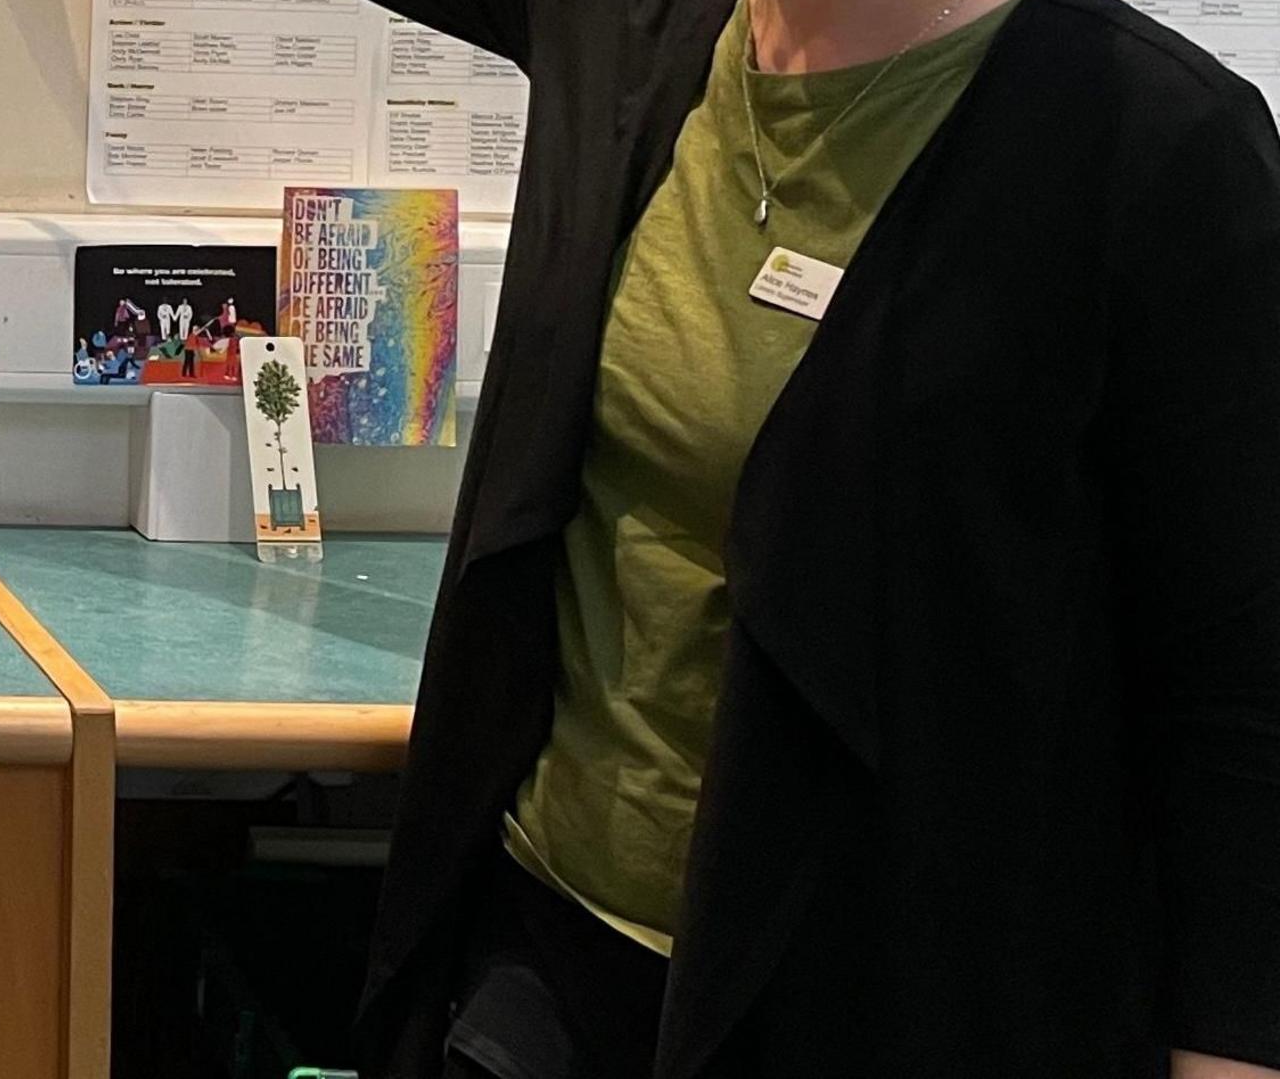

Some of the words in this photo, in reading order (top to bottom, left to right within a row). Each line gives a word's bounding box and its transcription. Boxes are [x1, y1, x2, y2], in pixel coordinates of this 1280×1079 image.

[294, 198, 342, 221] DON'T
[294, 223, 314, 245] BE
[318, 223, 371, 246] AFRAID
[293, 247, 313, 270] OF
[318, 248, 362, 270] BEING
[144, 278, 160, 286] not
[154, 268, 170, 276] you
[292, 296, 311, 318] BE
[315, 296, 369, 320] AFRAID
[292, 321, 311, 342] OF
[315, 321, 360, 343] BEING
[323, 345, 364, 368] SAME
